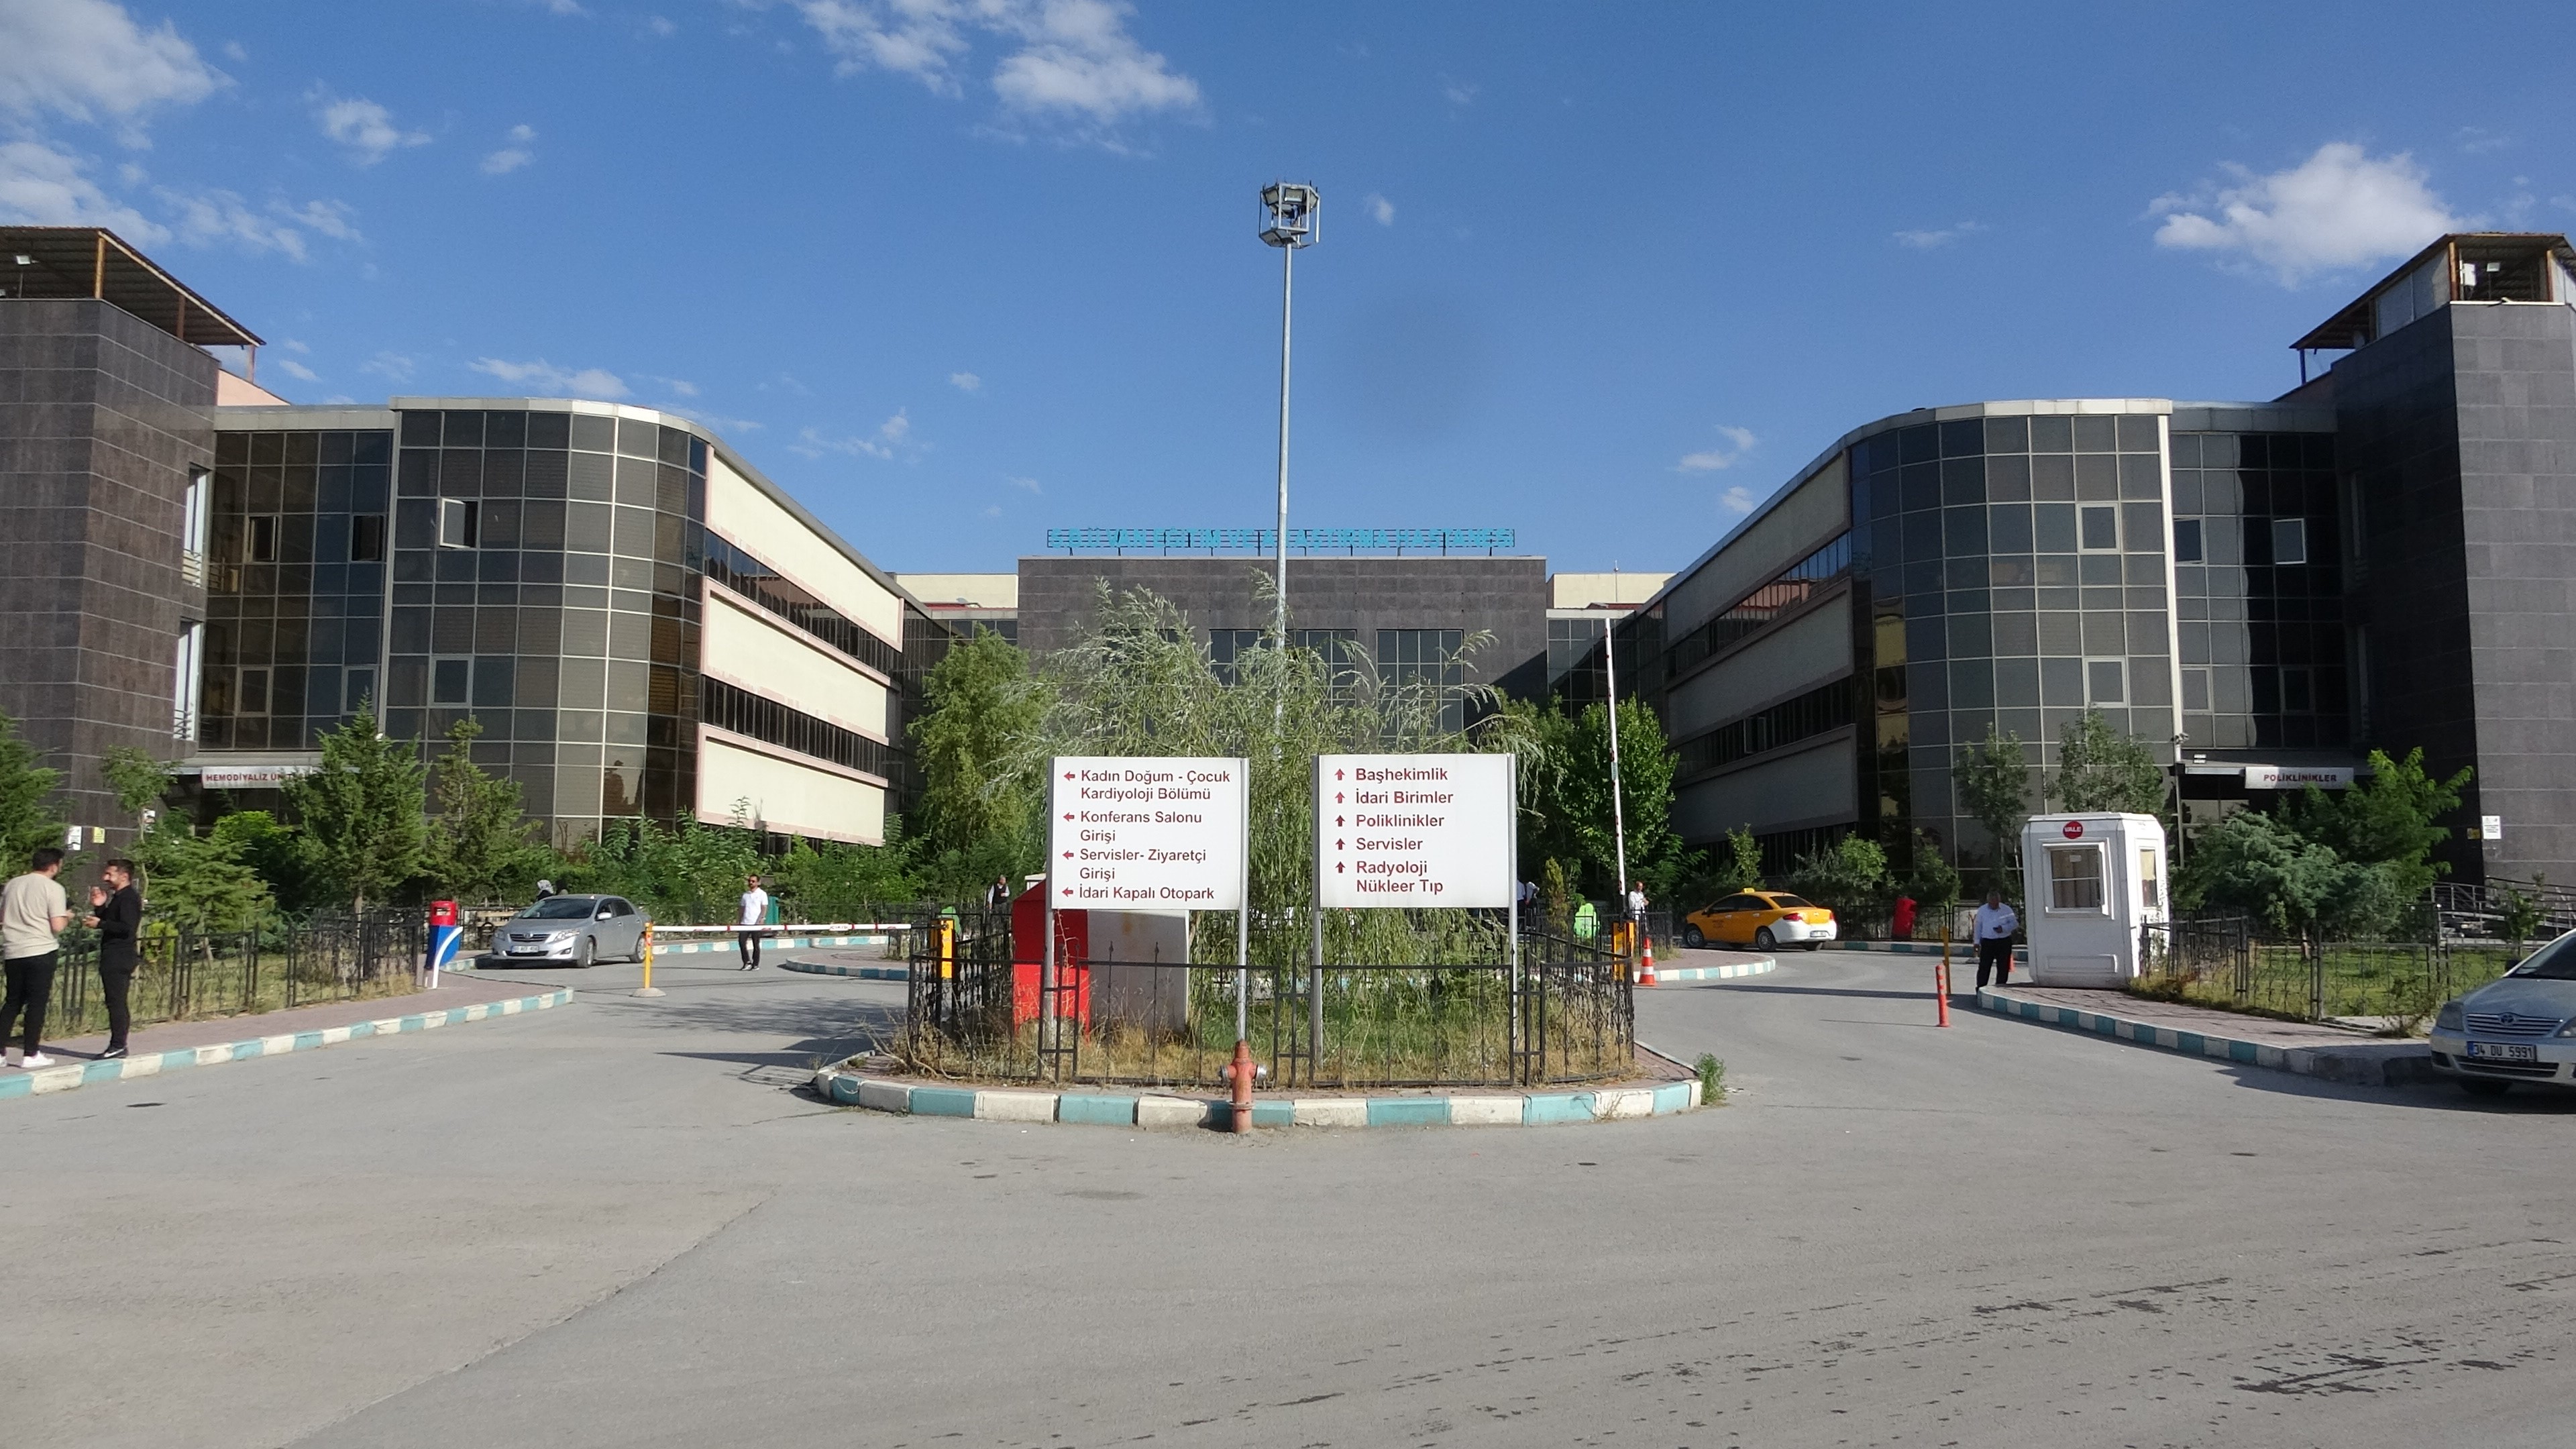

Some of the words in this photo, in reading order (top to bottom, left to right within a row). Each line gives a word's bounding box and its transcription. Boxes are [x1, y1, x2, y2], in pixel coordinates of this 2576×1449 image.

[206, 772, 267, 782] HEMODİYALİZ
[1081, 769, 1120, 782] Kadın
[1125, 769, 1173, 785] Doğum
[1187, 770, 1230, 786] Çocuk
[1356, 767, 1448, 784] Başhekimlik
[2263, 773, 2337, 782] POLİKLİNİKLER
[1081, 787, 1153, 802] Kardiyoloji
[1158, 788, 1211, 800] Bölümü
[1356, 788, 1389, 804] İdari
[1393, 790, 1454, 804] Birimler
[1081, 810, 1150, 823] Konferans
[1155, 810, 1202, 823] Salonu
[1356, 814, 1445, 827] Poliklinikler
[1080, 829, 1116, 845] Girişi
[1356, 837, 1424, 851] Servisler
[1148, 849, 1206, 864] Ziyaretçi
[1079, 867, 1115, 883] Girişi
[1356, 860, 1428, 877] Radyoloji
[1079, 883, 1109, 899] İdari
[1113, 886, 1155, 902] Kapalı
[1160, 886, 1214, 902] Otopark
[1356, 879, 1415, 893] Nükleer
[1419, 879, 1444, 896] Tıp
[2473, 1044, 2485, 1055] 34
[2491, 1045, 2502, 1057] DU
